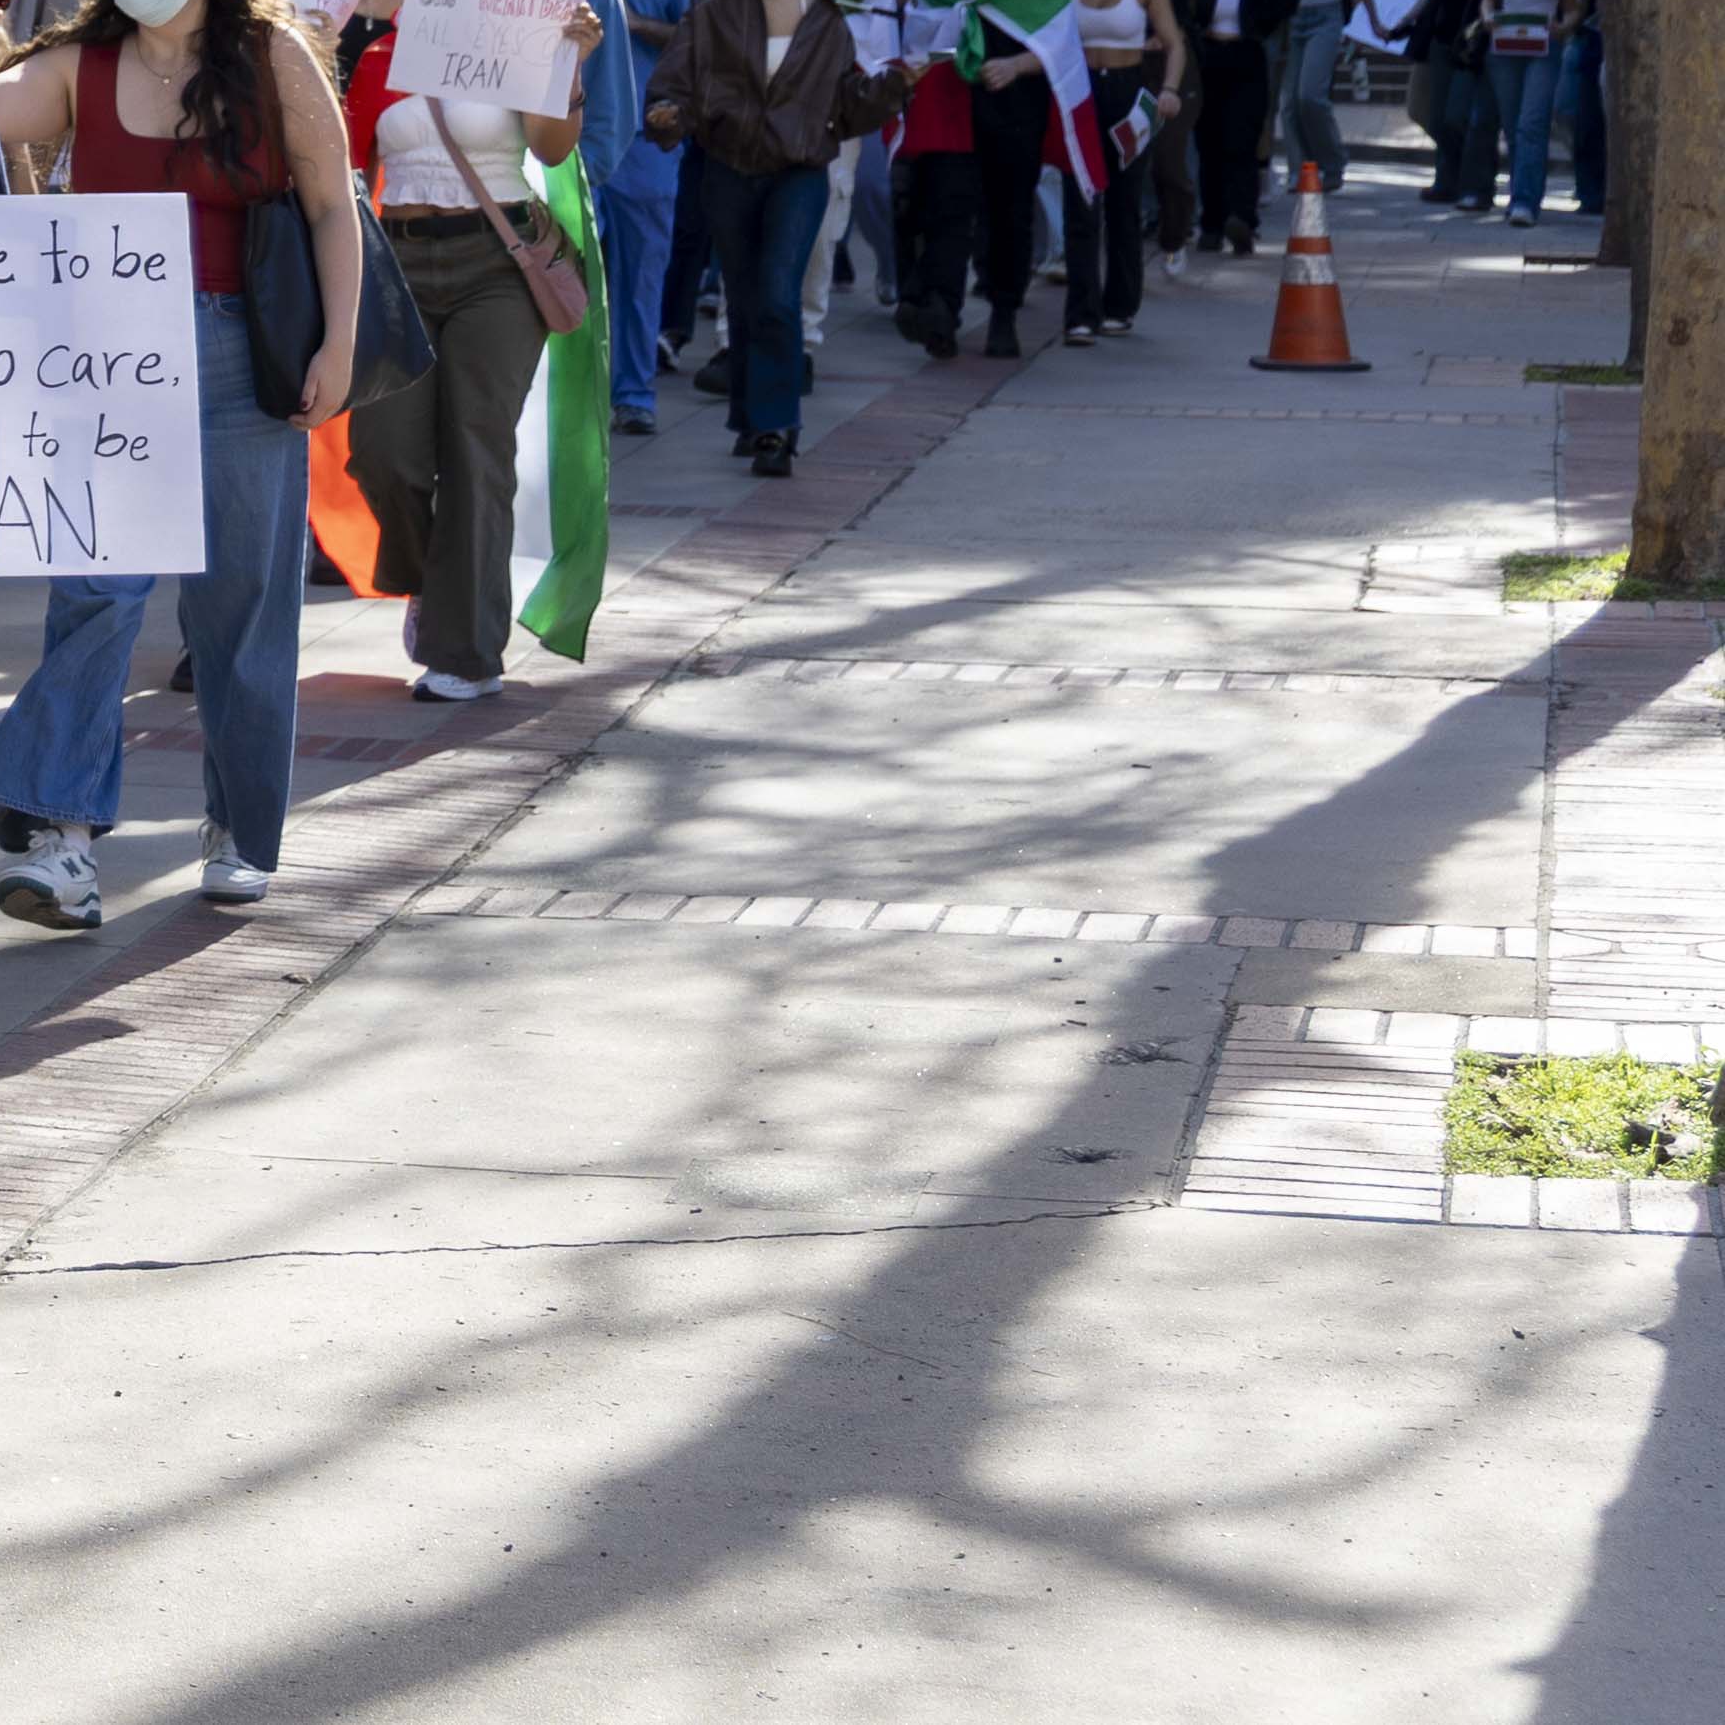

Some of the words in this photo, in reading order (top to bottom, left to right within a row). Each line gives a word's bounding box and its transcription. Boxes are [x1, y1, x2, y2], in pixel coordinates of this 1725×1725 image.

[440, 52, 509, 91] IRAN
[41, 220, 87, 285] to
[111, 224, 168, 282] be
[22, 411, 61, 459] to
[95, 413, 150, 462] be
